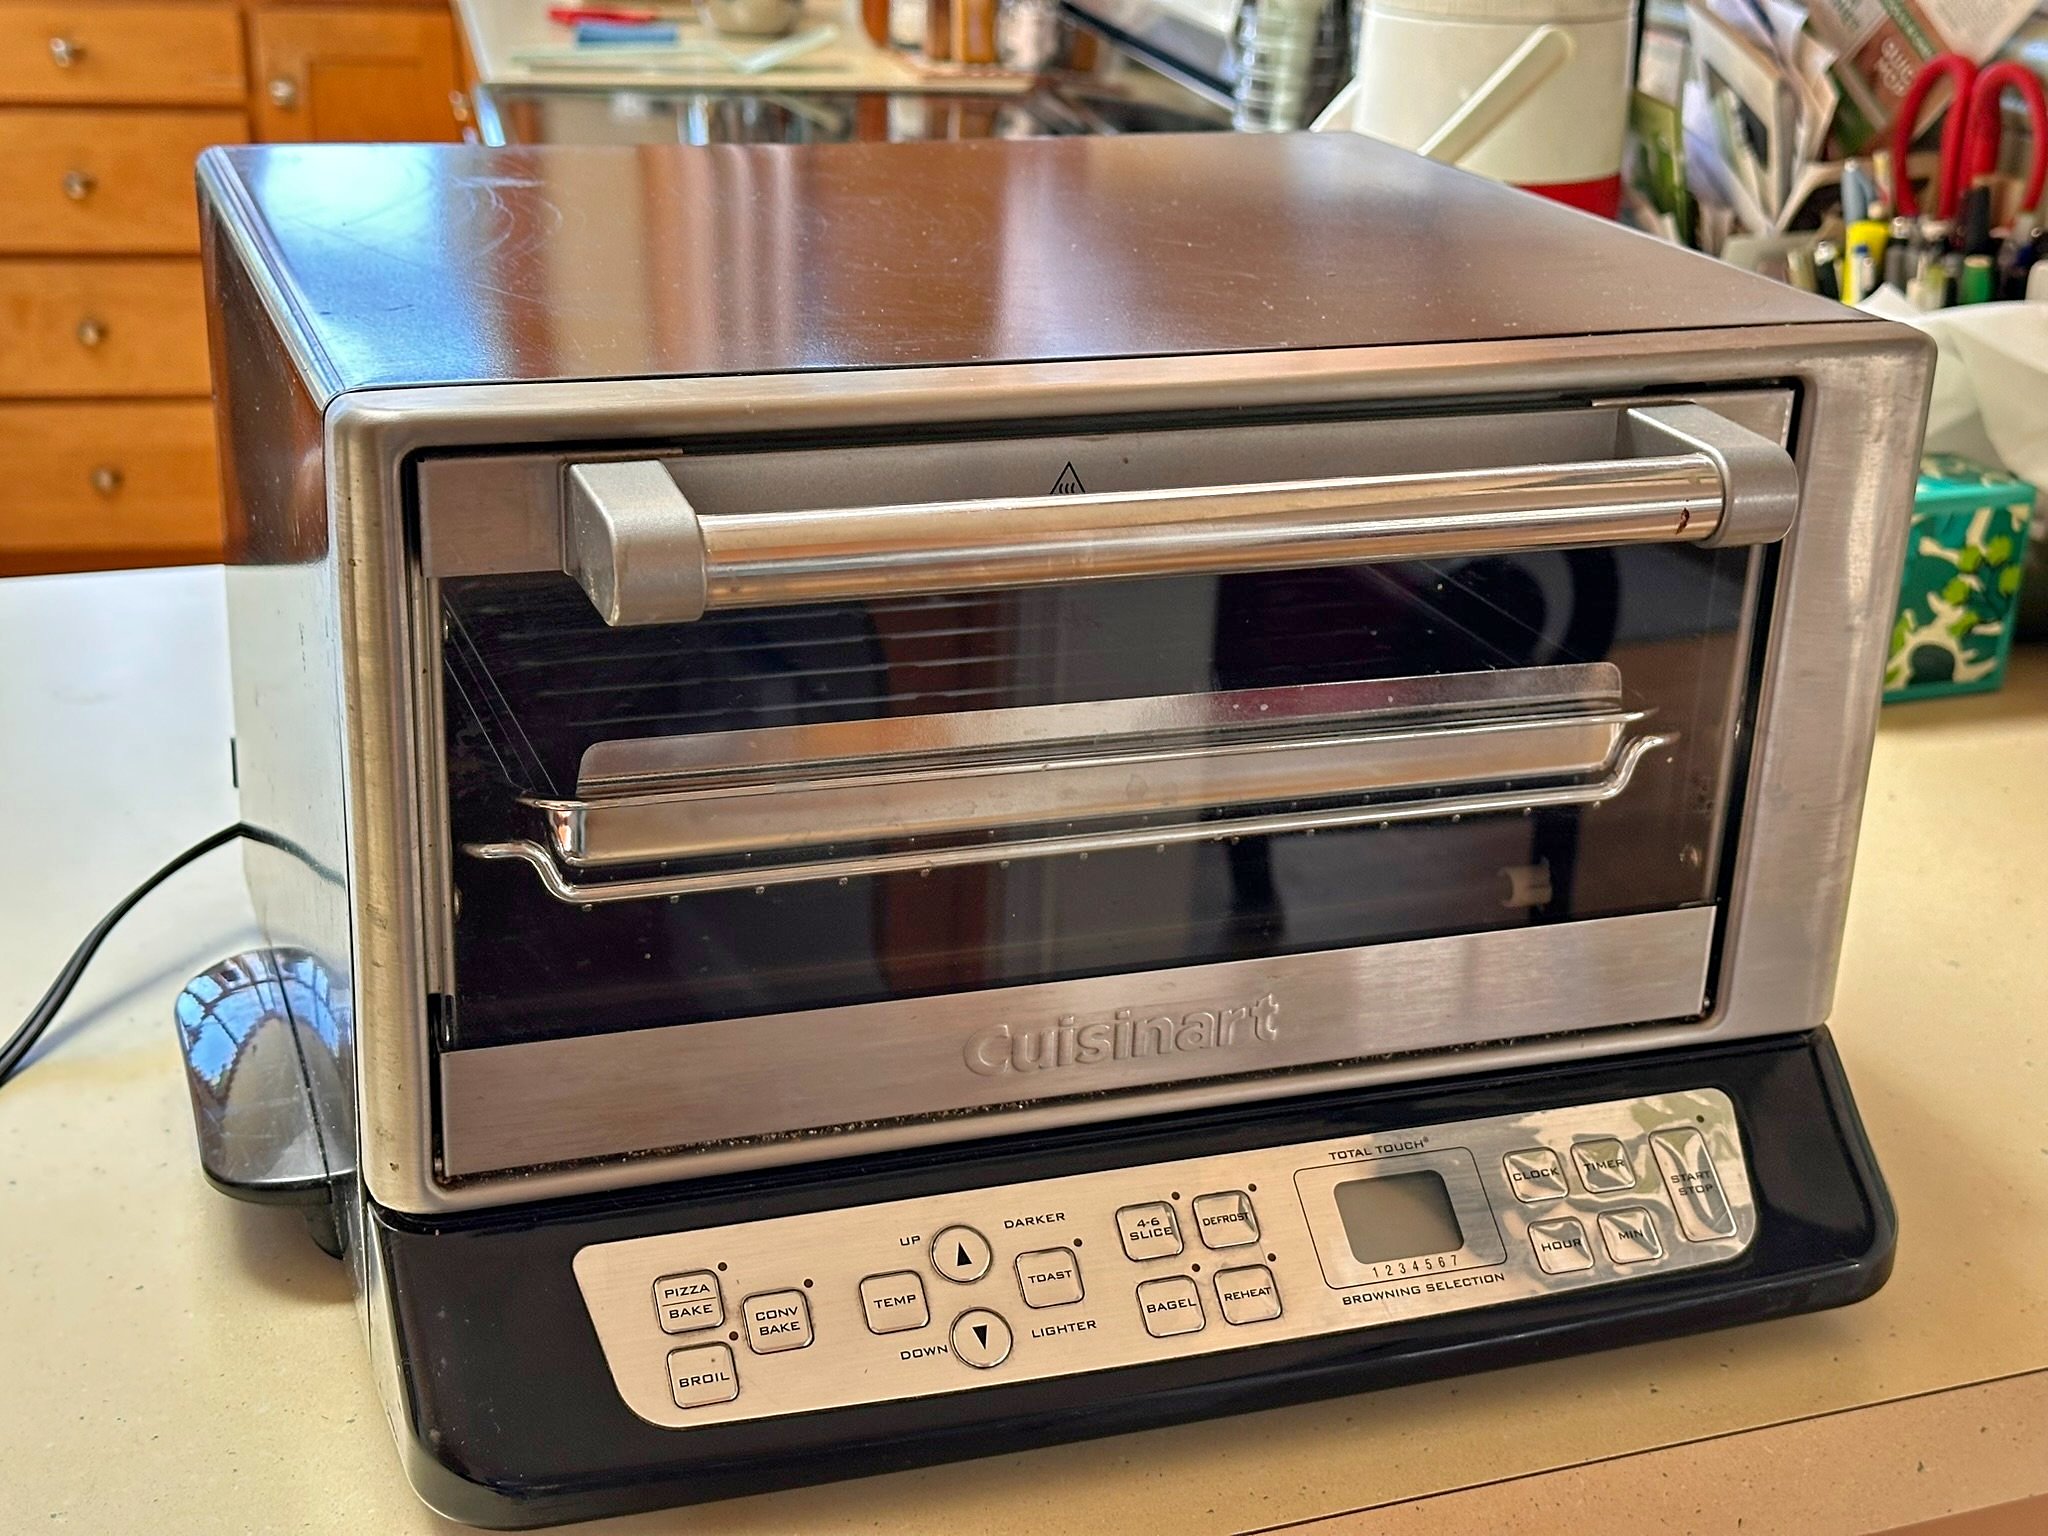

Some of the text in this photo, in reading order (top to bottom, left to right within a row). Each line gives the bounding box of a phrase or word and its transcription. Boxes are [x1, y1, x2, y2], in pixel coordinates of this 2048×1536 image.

[963, 993, 1279, 1076] Cuisinart
[1328, 1148, 1372, 1160] TOTAL
[1583, 1159, 1625, 1172] TIMER
[1513, 1167, 1560, 1182] CLOCK
[1671, 1170, 1712, 1184] START
[1678, 1184, 1713, 1196] STOP
[1004, 1212, 1066, 1229] DARKER
[1137, 1217, 1160, 1228] 4-6
[1202, 1212, 1249, 1226] DEFROST
[900, 1235, 921, 1246] UP
[1129, 1226, 1174, 1241] SLICE
[1618, 1229, 1644, 1240] MIN
[1541, 1238, 1582, 1252] HOUR
[1385, 1264, 1394, 1276] 2
[1399, 1262, 1407, 1274] 3
[1412, 1260, 1420, 1272] 4
[1425, 1257, 1433, 1270] 5
[1438, 1256, 1446, 1268] 6
[1451, 1254, 1459, 1266] 7
[1028, 1270, 1073, 1284] TOAST
[664, 1284, 711, 1299] PIZZA
[1224, 1287, 1272, 1301] REHEAT
[1342, 1273, 1505, 1306] BROWNING SELECTION
[874, 1294, 917, 1309] TEMP
[1146, 1298, 1197, 1314] BAGEL
[669, 1304, 713, 1319] BAKE
[755, 1306, 799, 1322] CONV
[759, 1321, 801, 1336] BAKE
[1031, 1320, 1098, 1338] LIGHTER
[900, 1345, 949, 1361] DOWN
[679, 1372, 730, 1388] BROIL
